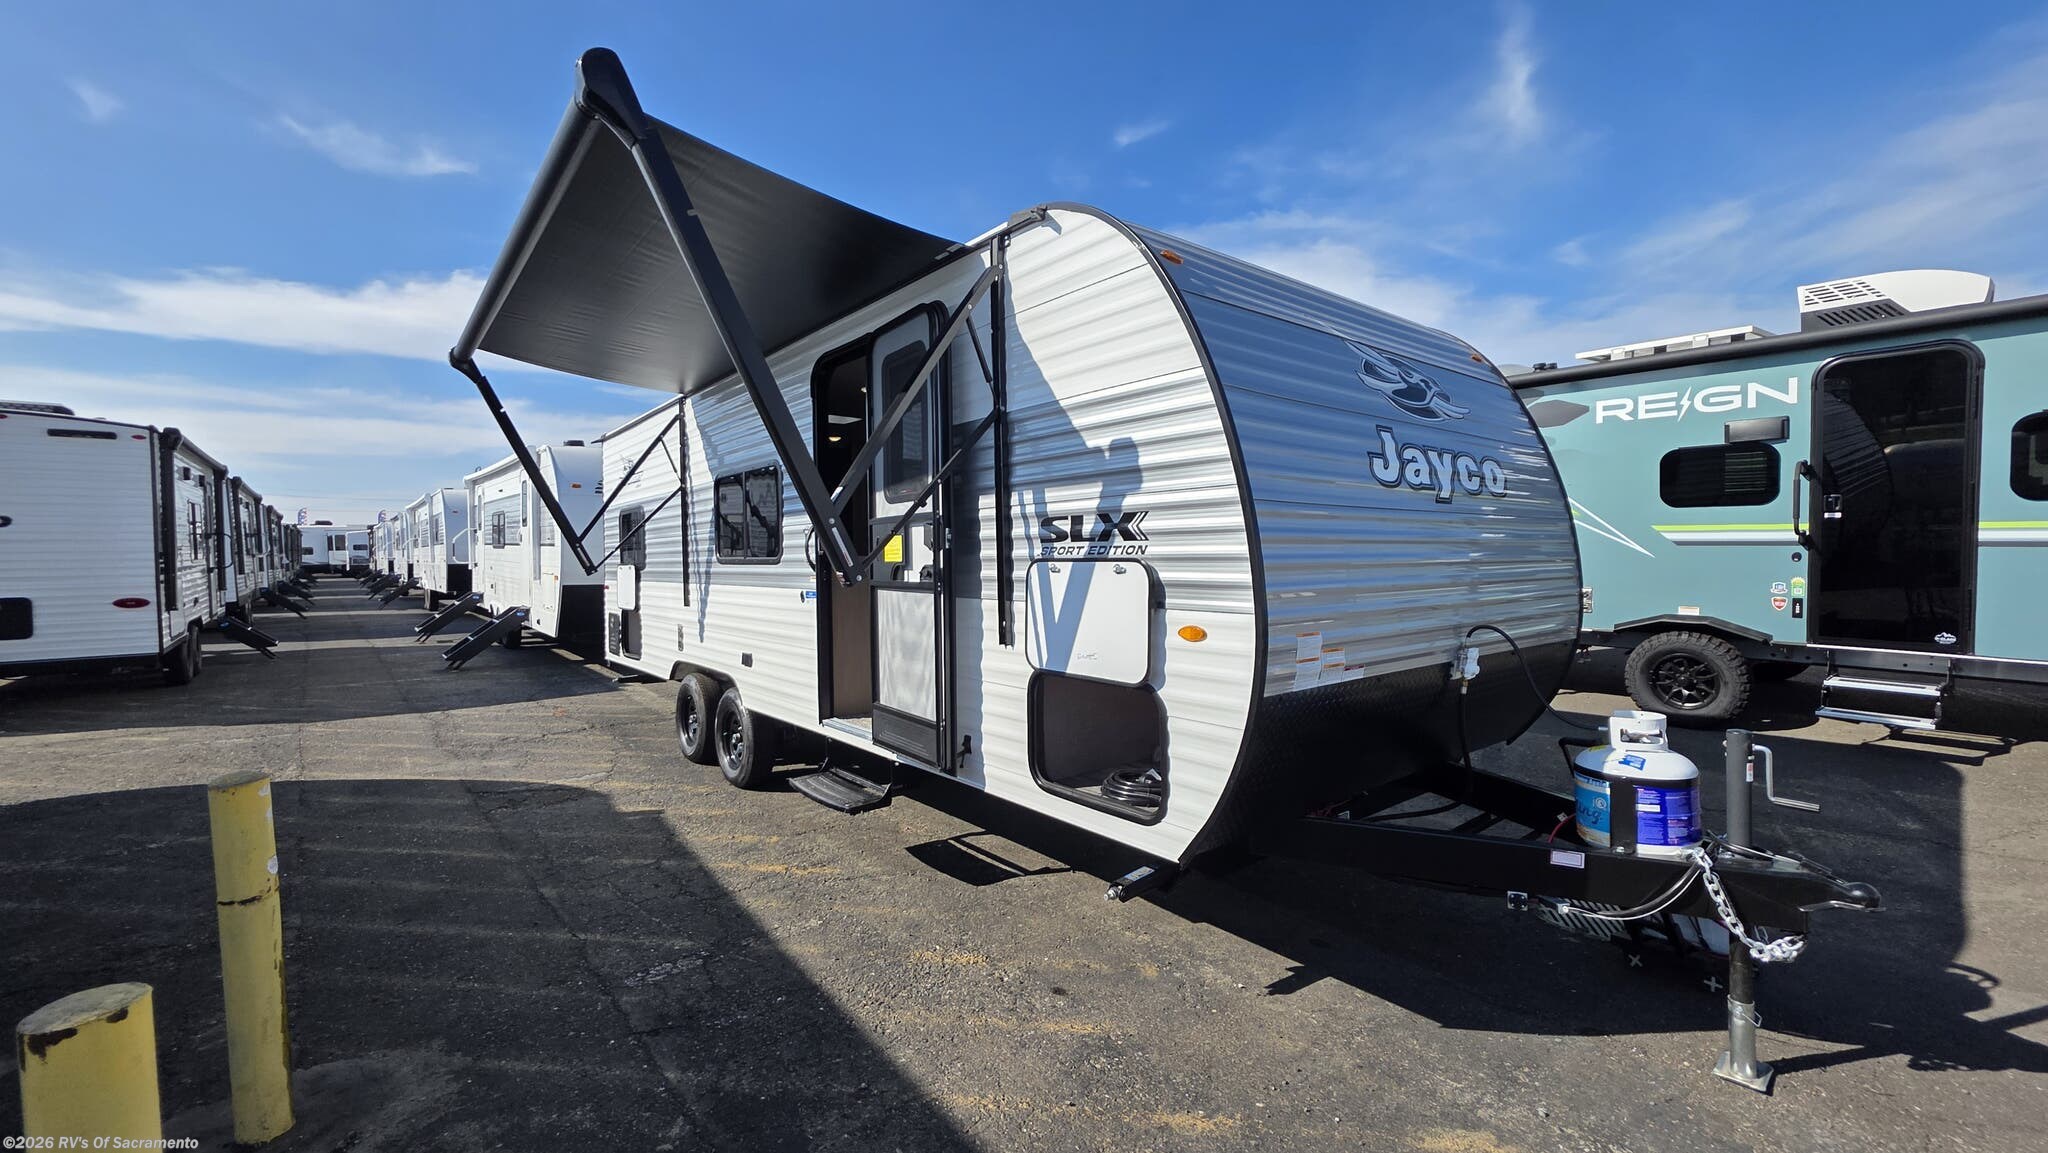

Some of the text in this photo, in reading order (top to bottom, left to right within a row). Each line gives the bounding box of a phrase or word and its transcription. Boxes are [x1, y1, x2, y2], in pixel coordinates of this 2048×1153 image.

[1366, 424, 1508, 504] Jayco
[1040, 510, 1150, 543] SLX
[1040, 544, 1149, 556] SPORT EDITION
